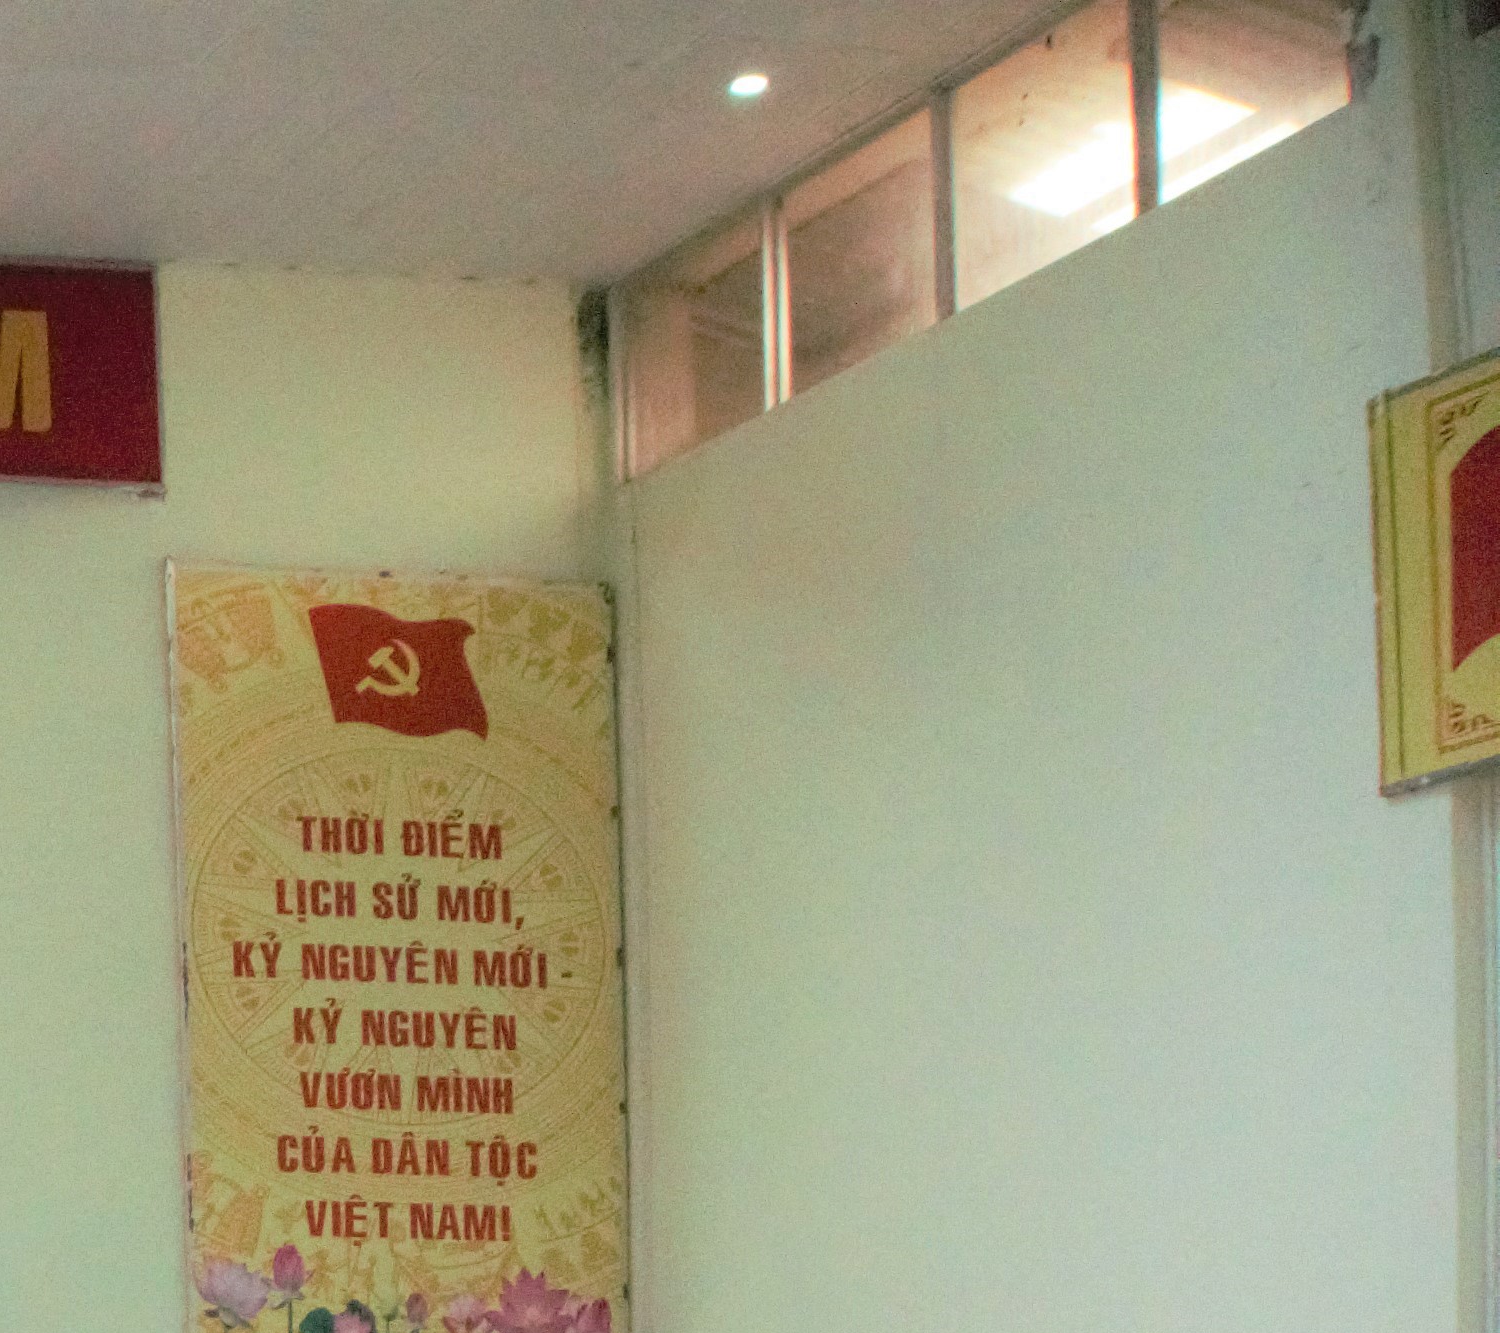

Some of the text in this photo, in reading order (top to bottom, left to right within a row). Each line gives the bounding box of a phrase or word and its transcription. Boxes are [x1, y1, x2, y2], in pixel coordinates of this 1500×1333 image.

[297, 809, 502, 859] THỜI ĐIỂM
[276, 875, 523, 930] LỊCH SỬ MỚI,
[233, 933, 281, 978] KỶ
[302, 942, 457, 984] NGUYÊN
[474, 945, 547, 988] MỚI
[294, 998, 516, 1051] KỶ NGUYÊN
[301, 1068, 513, 1114] VƯƠN MÌNH
[278, 1126, 537, 1186] CỦA DÂN TỘC
[306, 1195, 510, 1246] VIỆT NAM!
